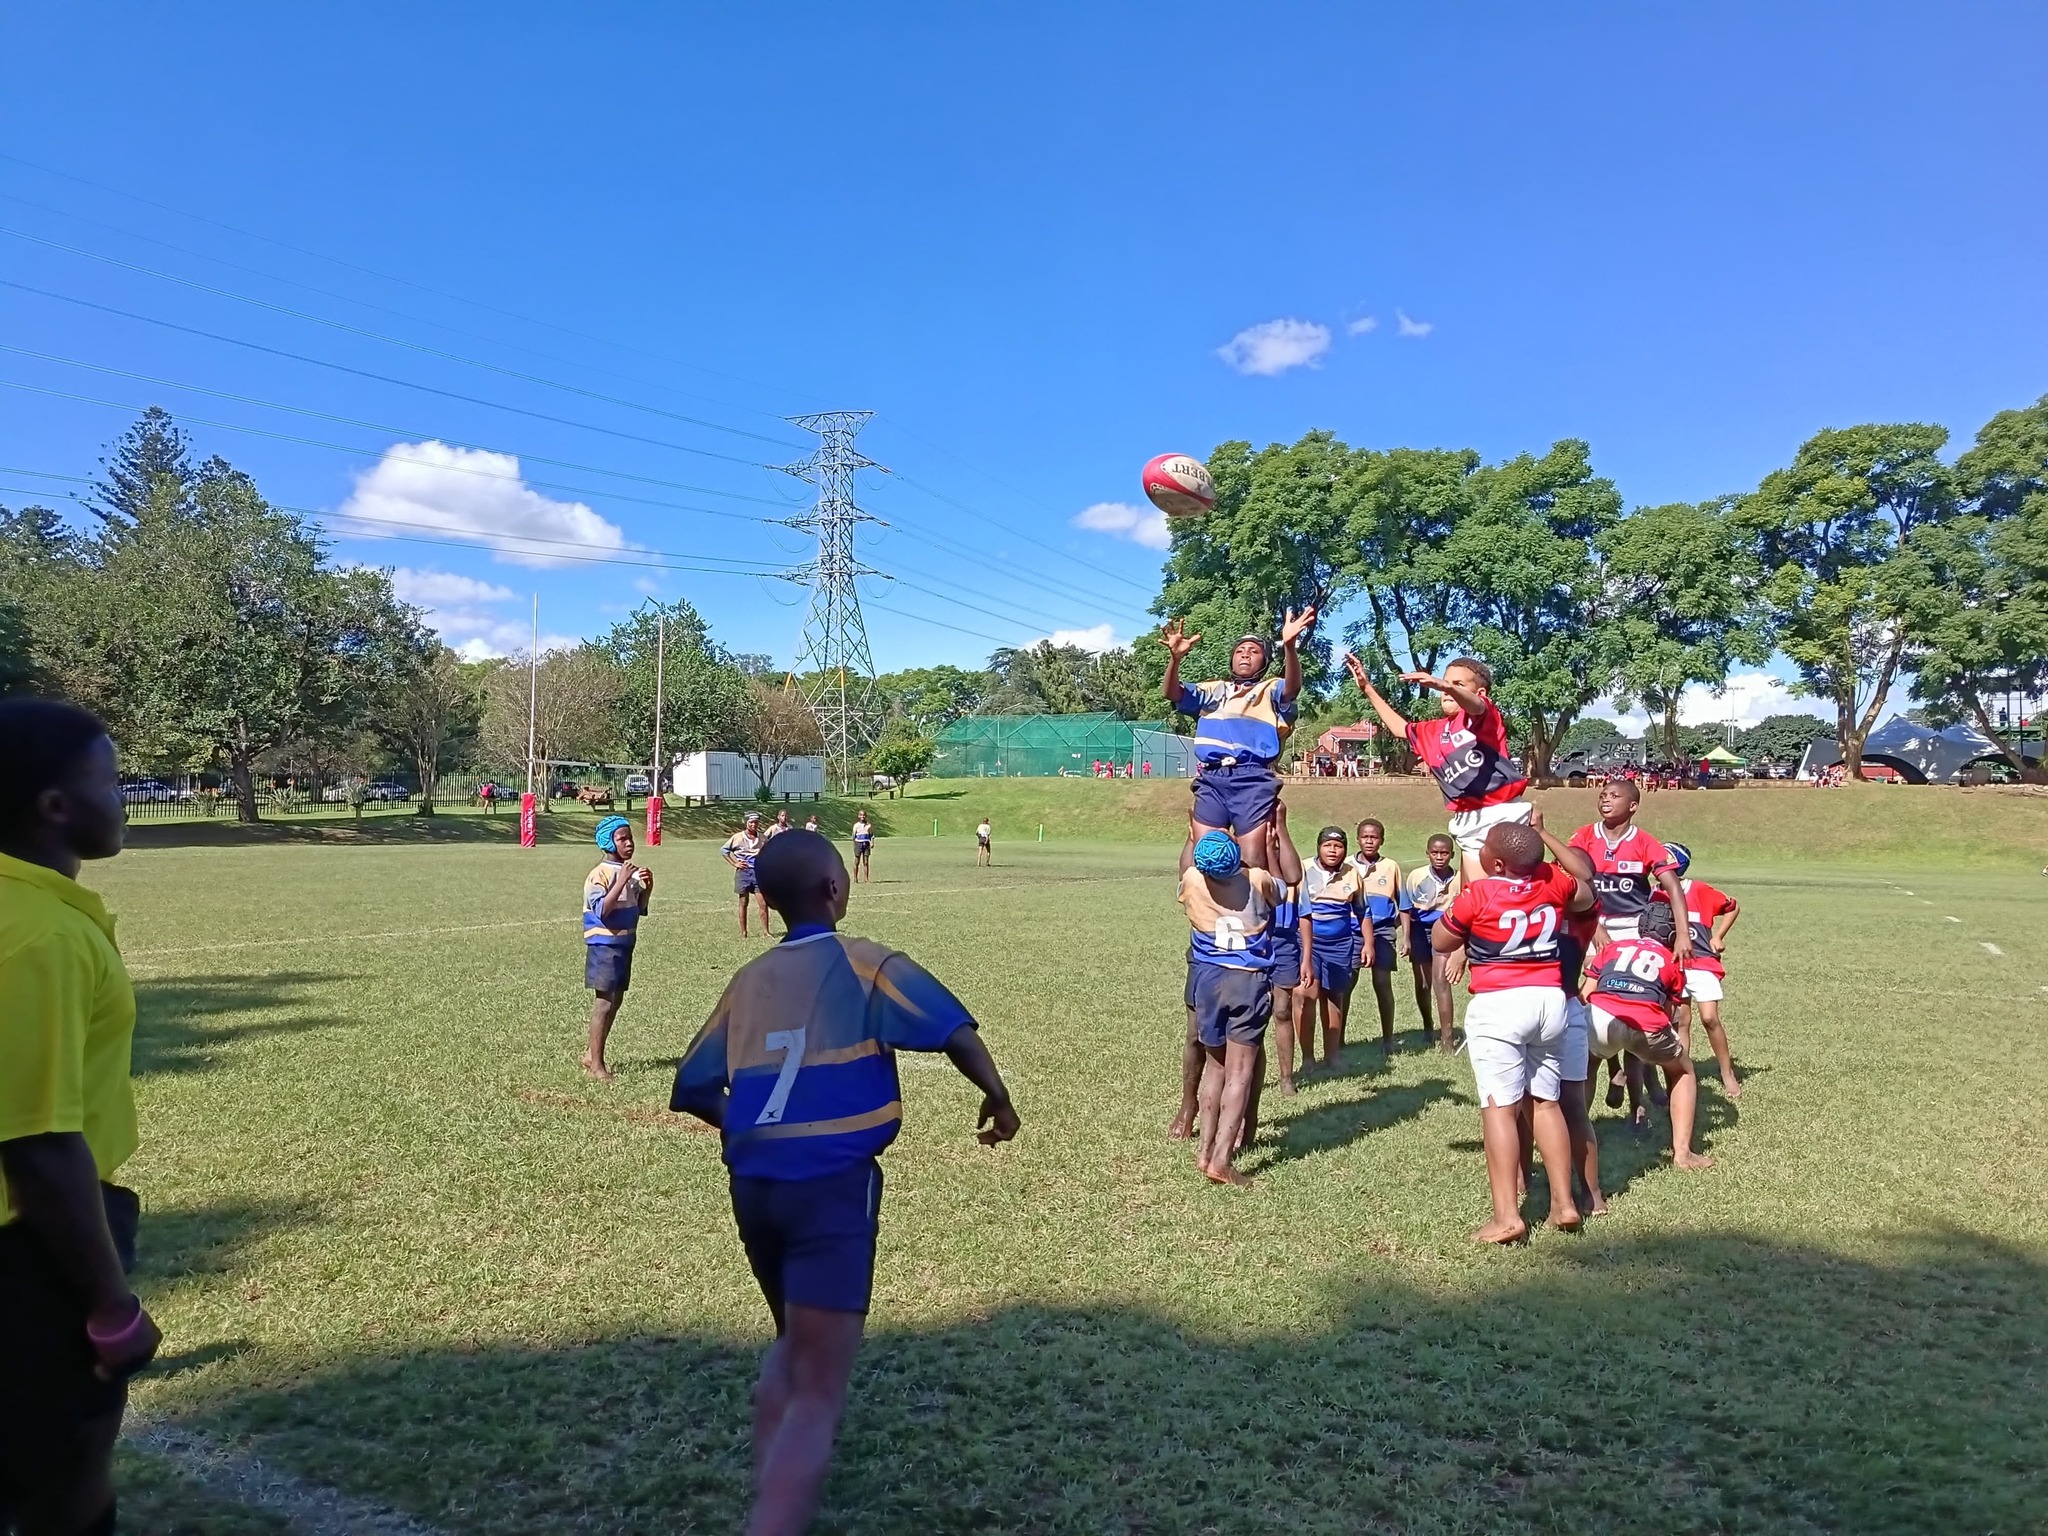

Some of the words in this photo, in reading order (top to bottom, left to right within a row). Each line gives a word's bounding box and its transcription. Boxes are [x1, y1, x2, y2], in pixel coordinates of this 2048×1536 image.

[1600, 742, 1639, 752] STAGE
[1498, 903, 1558, 957] 22
[1613, 945, 1666, 983] 18
[755, 1024, 807, 1126] 7
